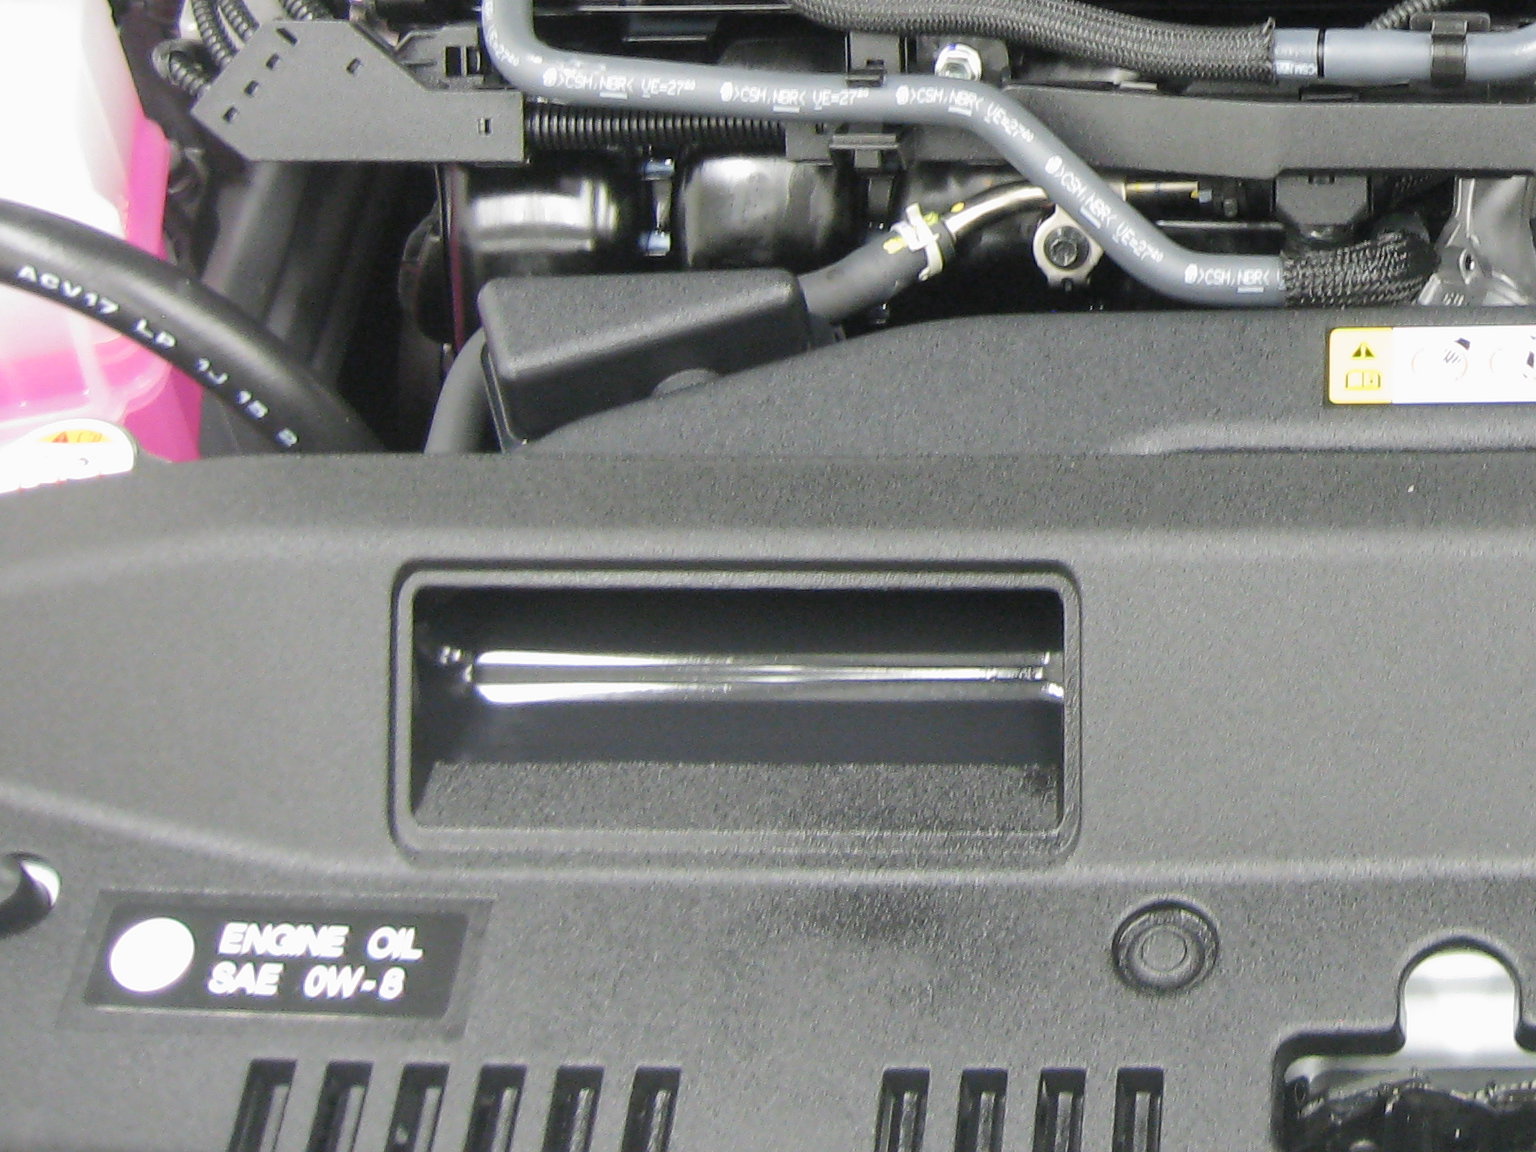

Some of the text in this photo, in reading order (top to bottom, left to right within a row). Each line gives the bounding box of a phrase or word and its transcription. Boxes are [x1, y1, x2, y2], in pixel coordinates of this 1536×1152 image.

[217, 921, 424, 962] ENGINE OIL
[207, 960, 285, 997] SAE
